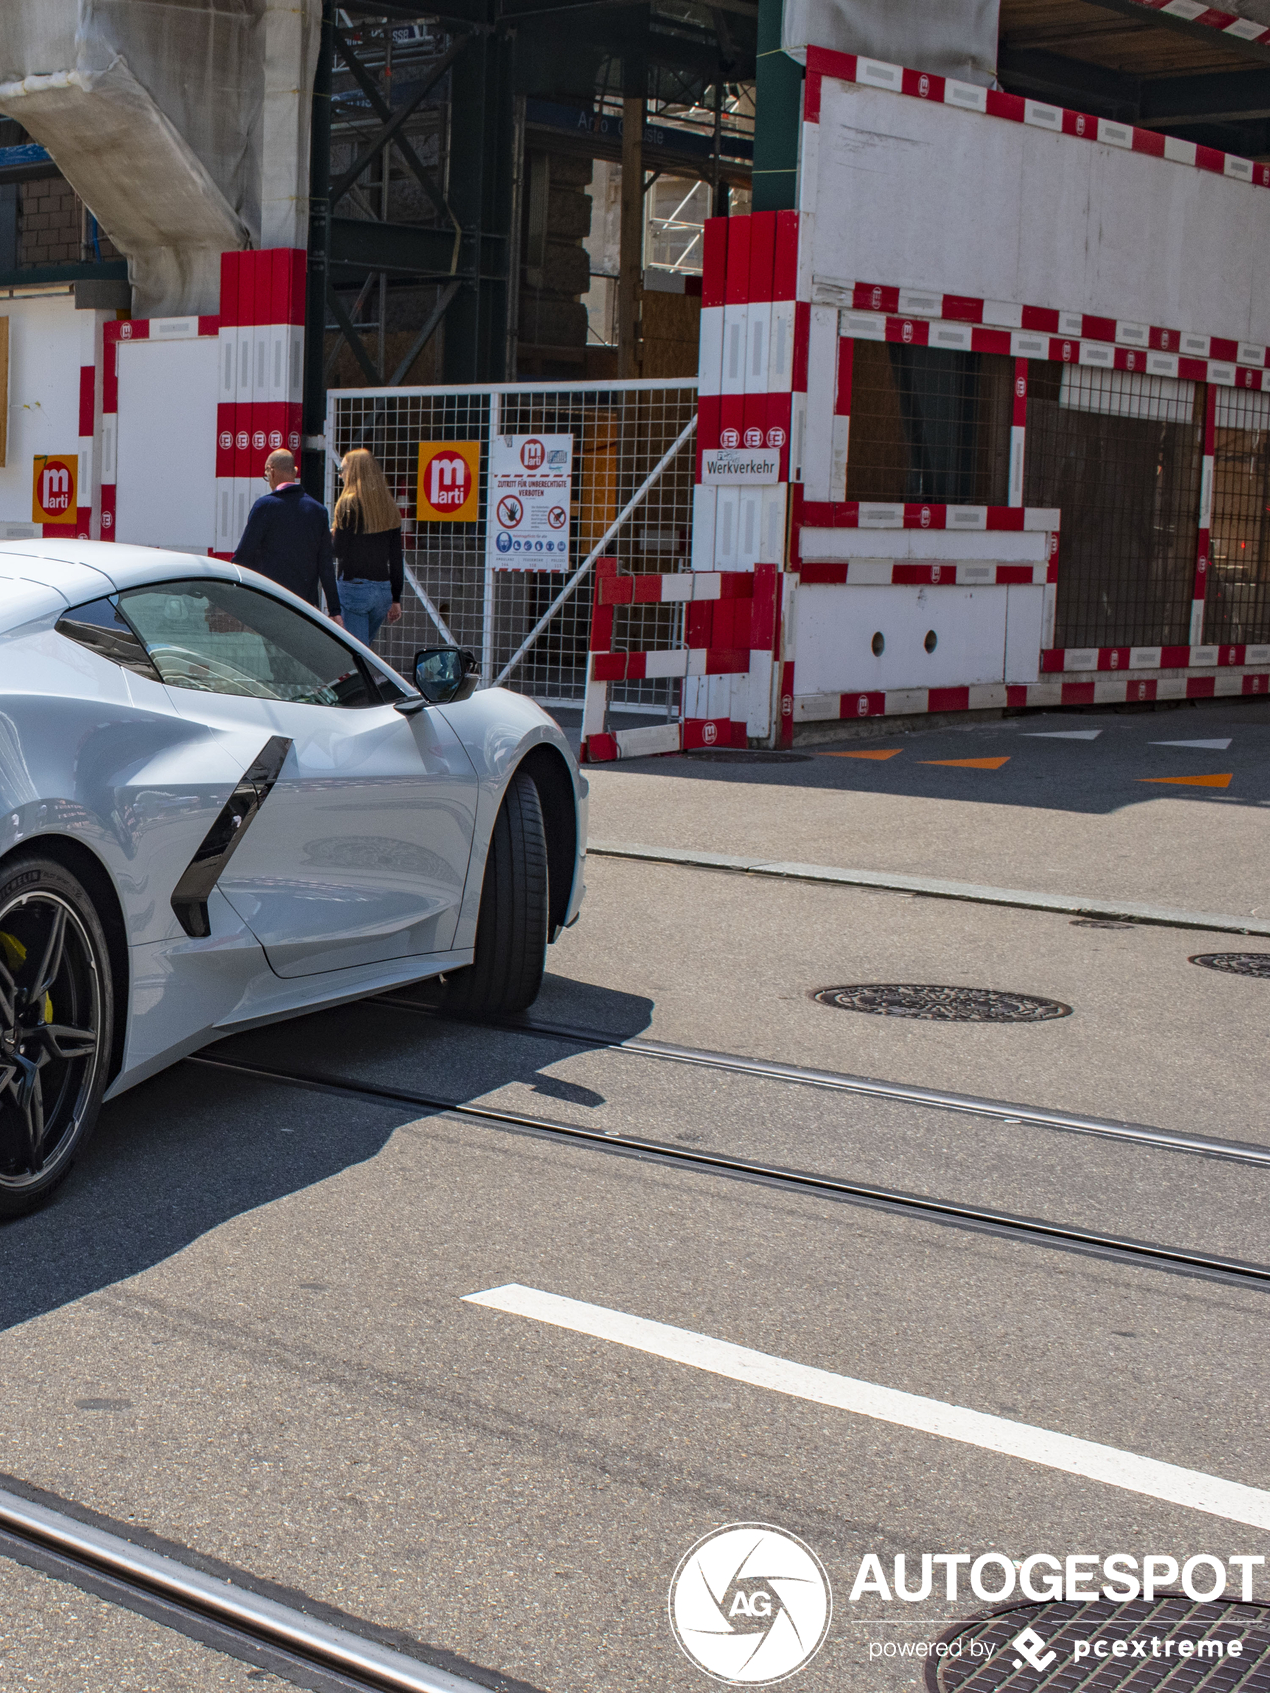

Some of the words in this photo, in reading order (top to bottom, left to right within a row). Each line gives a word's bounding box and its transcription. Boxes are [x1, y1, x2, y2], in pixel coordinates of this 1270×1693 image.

[707, 459, 775, 474] Werkverkehr
[42, 468, 69, 509] marti
[430, 458, 465, 504] marti
[497, 480, 517, 488] ZUTRITT
[528, 480, 567, 488] UNBERECHTIGTE
[518, 489, 544, 497] VERBOTEN
